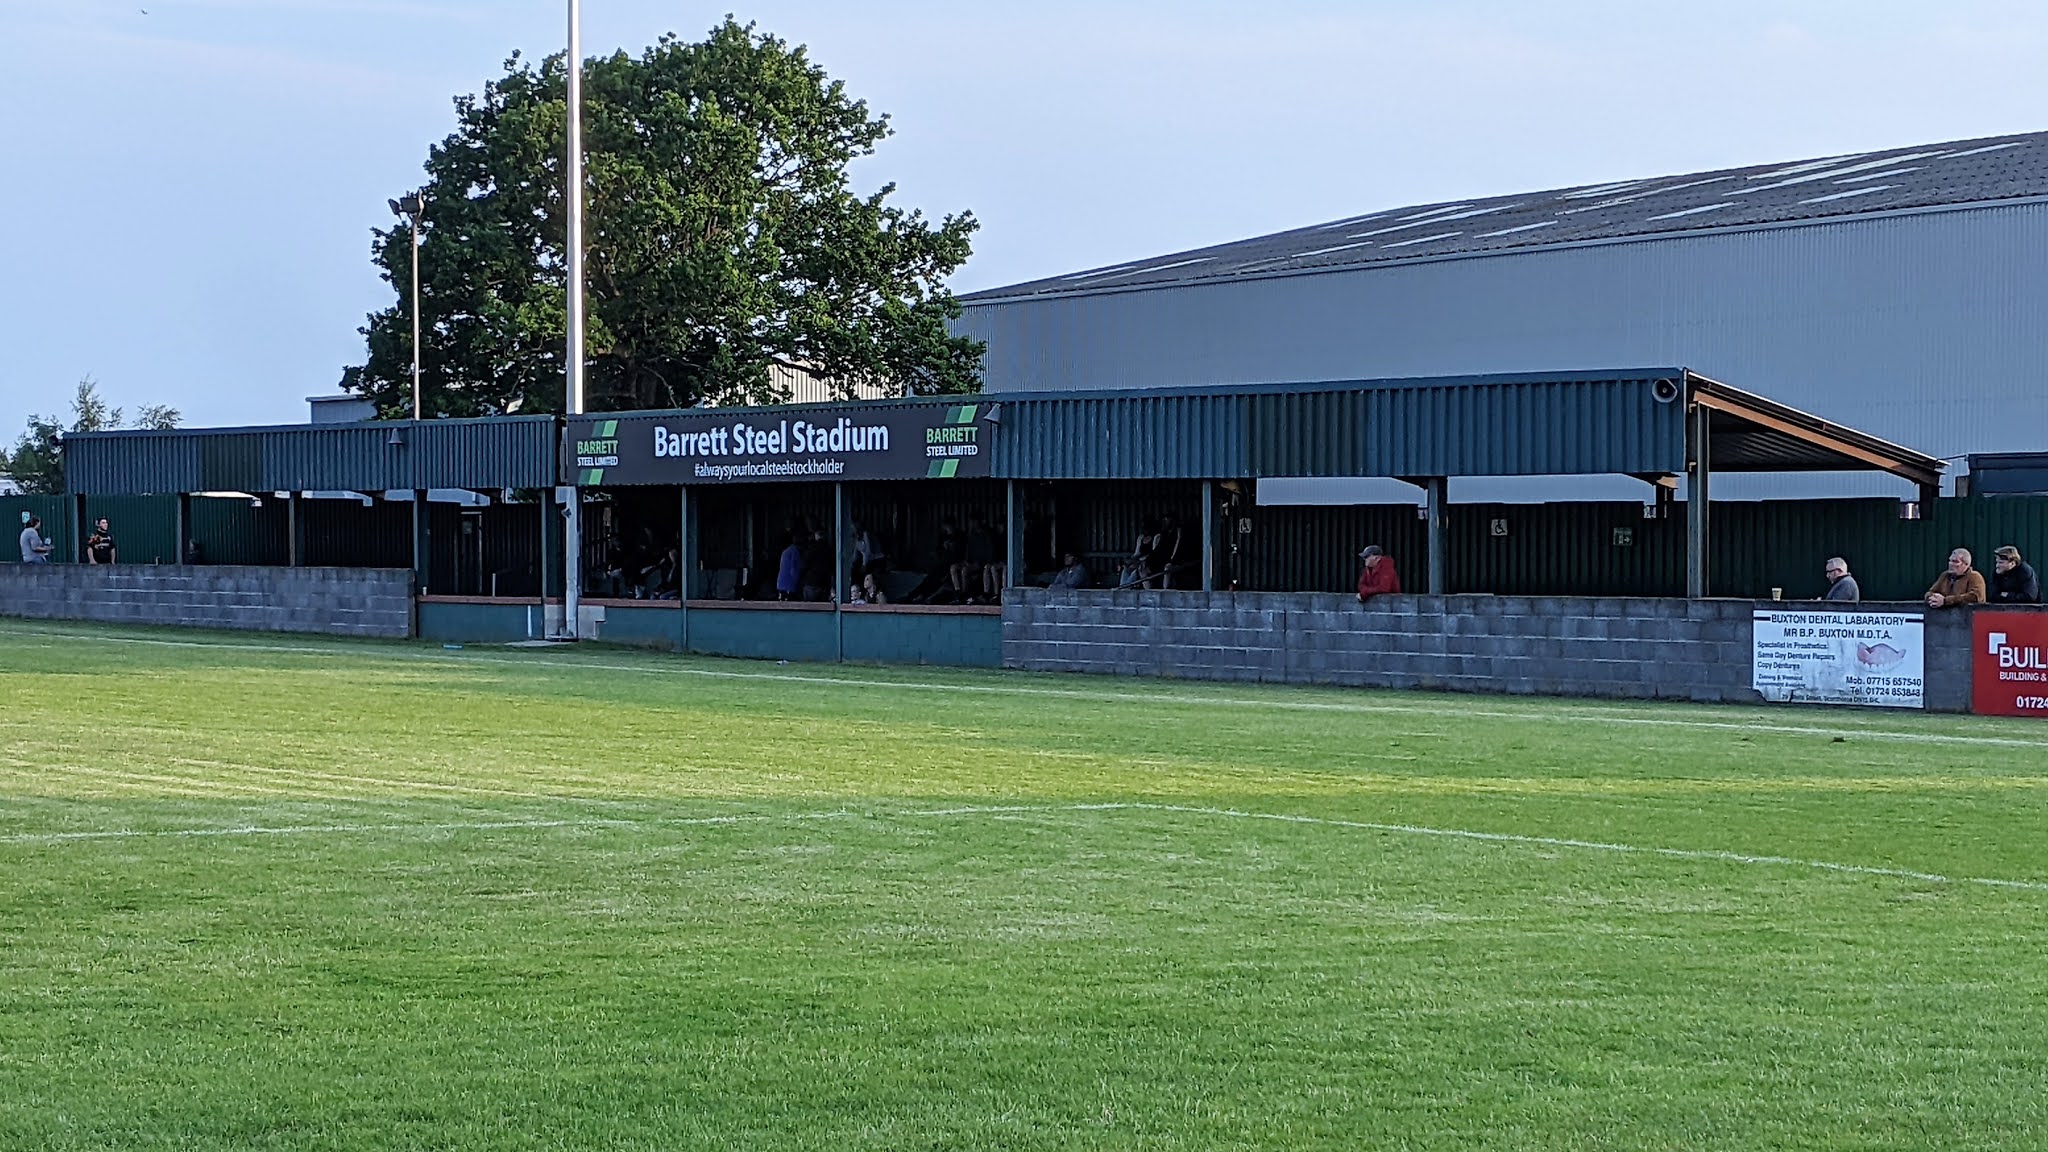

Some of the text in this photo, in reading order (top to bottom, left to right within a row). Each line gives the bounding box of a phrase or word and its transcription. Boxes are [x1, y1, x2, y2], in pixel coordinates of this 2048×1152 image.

[654, 417, 889, 457] Barrett Steel Stadium
[927, 427, 978, 443] BARRETT
[577, 440, 618, 455] BARRETT
[926, 444, 978, 457] STEEL LIMITED
[577, 456, 619, 467] STEEL LIMITED
[694, 458, 845, 481] #alwaysyourlocalsteelstockholder
[1771, 614, 1905, 626] BUXTON DENTAL LABARATORY
[1783, 628, 1893, 640] MR B.P. BUXTON M.D.T.A.
[1757, 641, 1786, 649] Specialist
[1787, 652, 1811, 660] Denture
[1999, 646, 2048, 669] BUIL
[1757, 662, 1801, 671] Copy Dentures
[1866, 676, 1891, 686] 07715
[1999, 671, 2047, 682] BUILDING &
[1865, 687, 1890, 695] 01724
